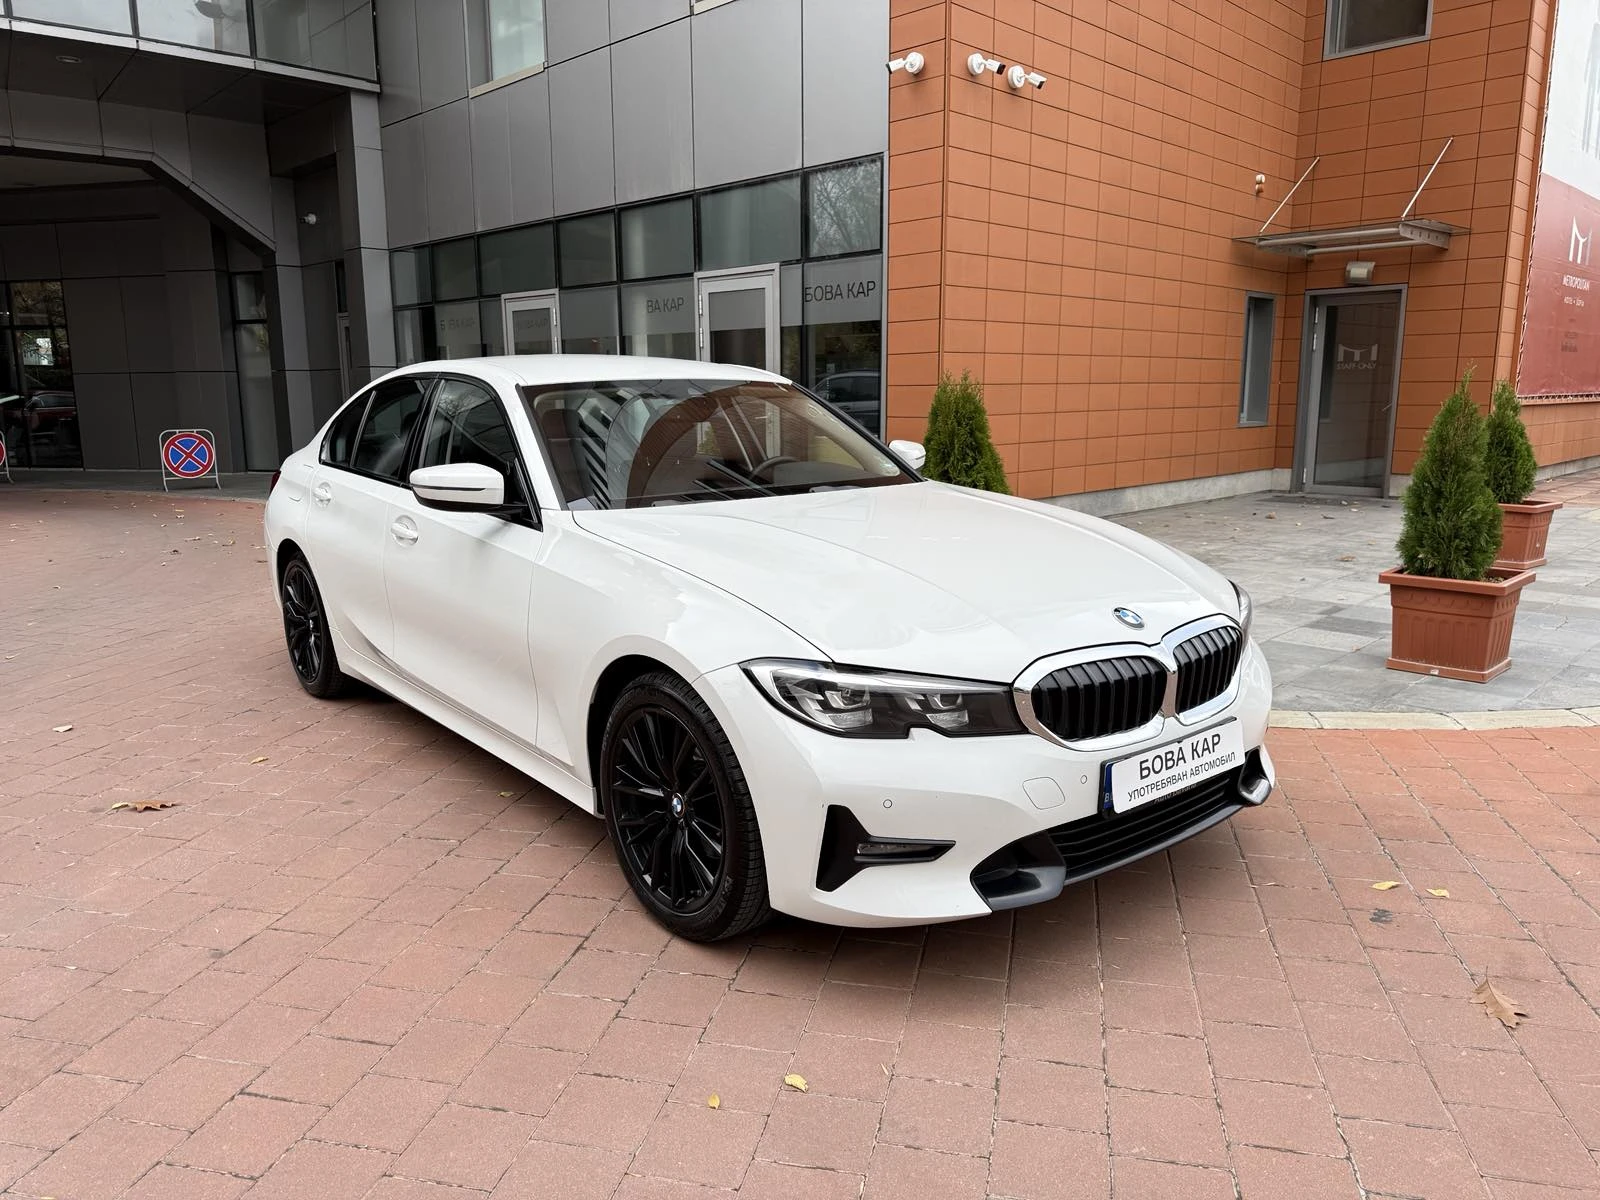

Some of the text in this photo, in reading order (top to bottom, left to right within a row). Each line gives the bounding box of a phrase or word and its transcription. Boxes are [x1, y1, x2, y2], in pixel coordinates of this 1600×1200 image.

[804, 280, 876, 303] БОВА КАР
[662, 296, 685, 313] КАР
[1358, 361, 1376, 369] ONLY
[1139, 732, 1222, 781] БОВА КАР
[1127, 751, 1236, 802] УПОТРЕБЯВАН АВТОМОБИЛ
